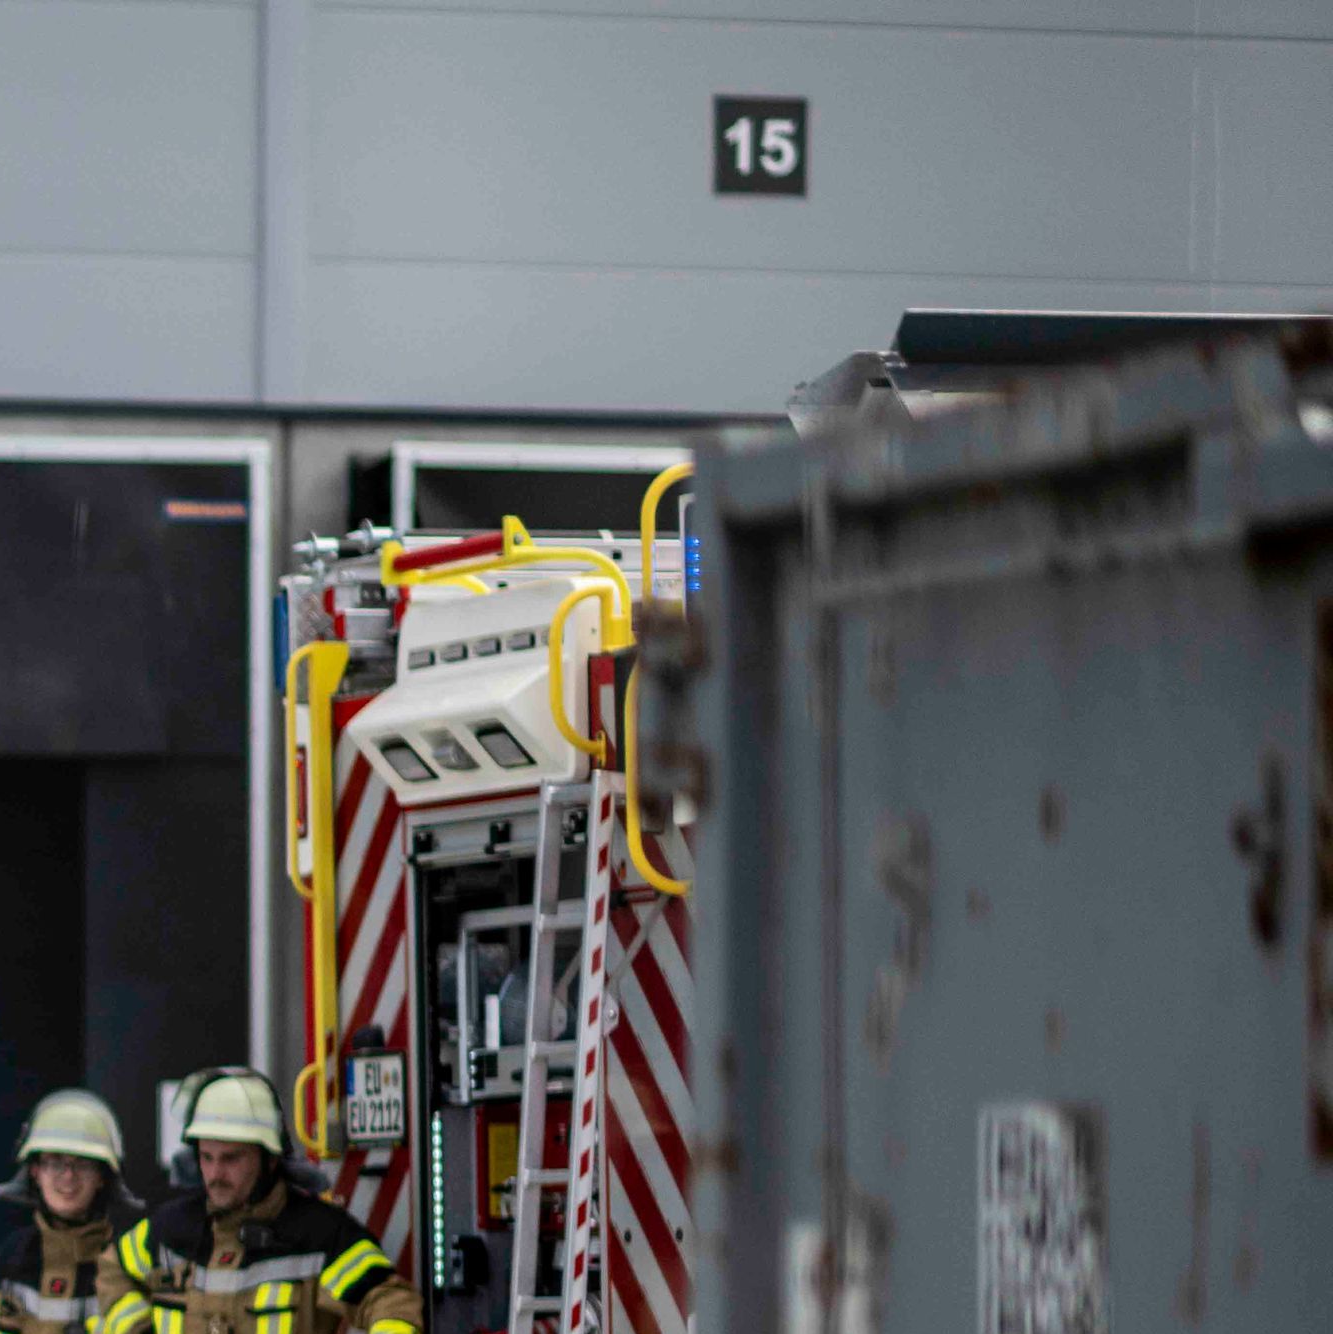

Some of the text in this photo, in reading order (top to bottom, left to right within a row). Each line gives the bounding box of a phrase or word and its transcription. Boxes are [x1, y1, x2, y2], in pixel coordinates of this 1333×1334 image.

[724, 117, 798, 177] 15
[365, 1062, 381, 1096] EU
[369, 1098, 400, 1133] 2112
